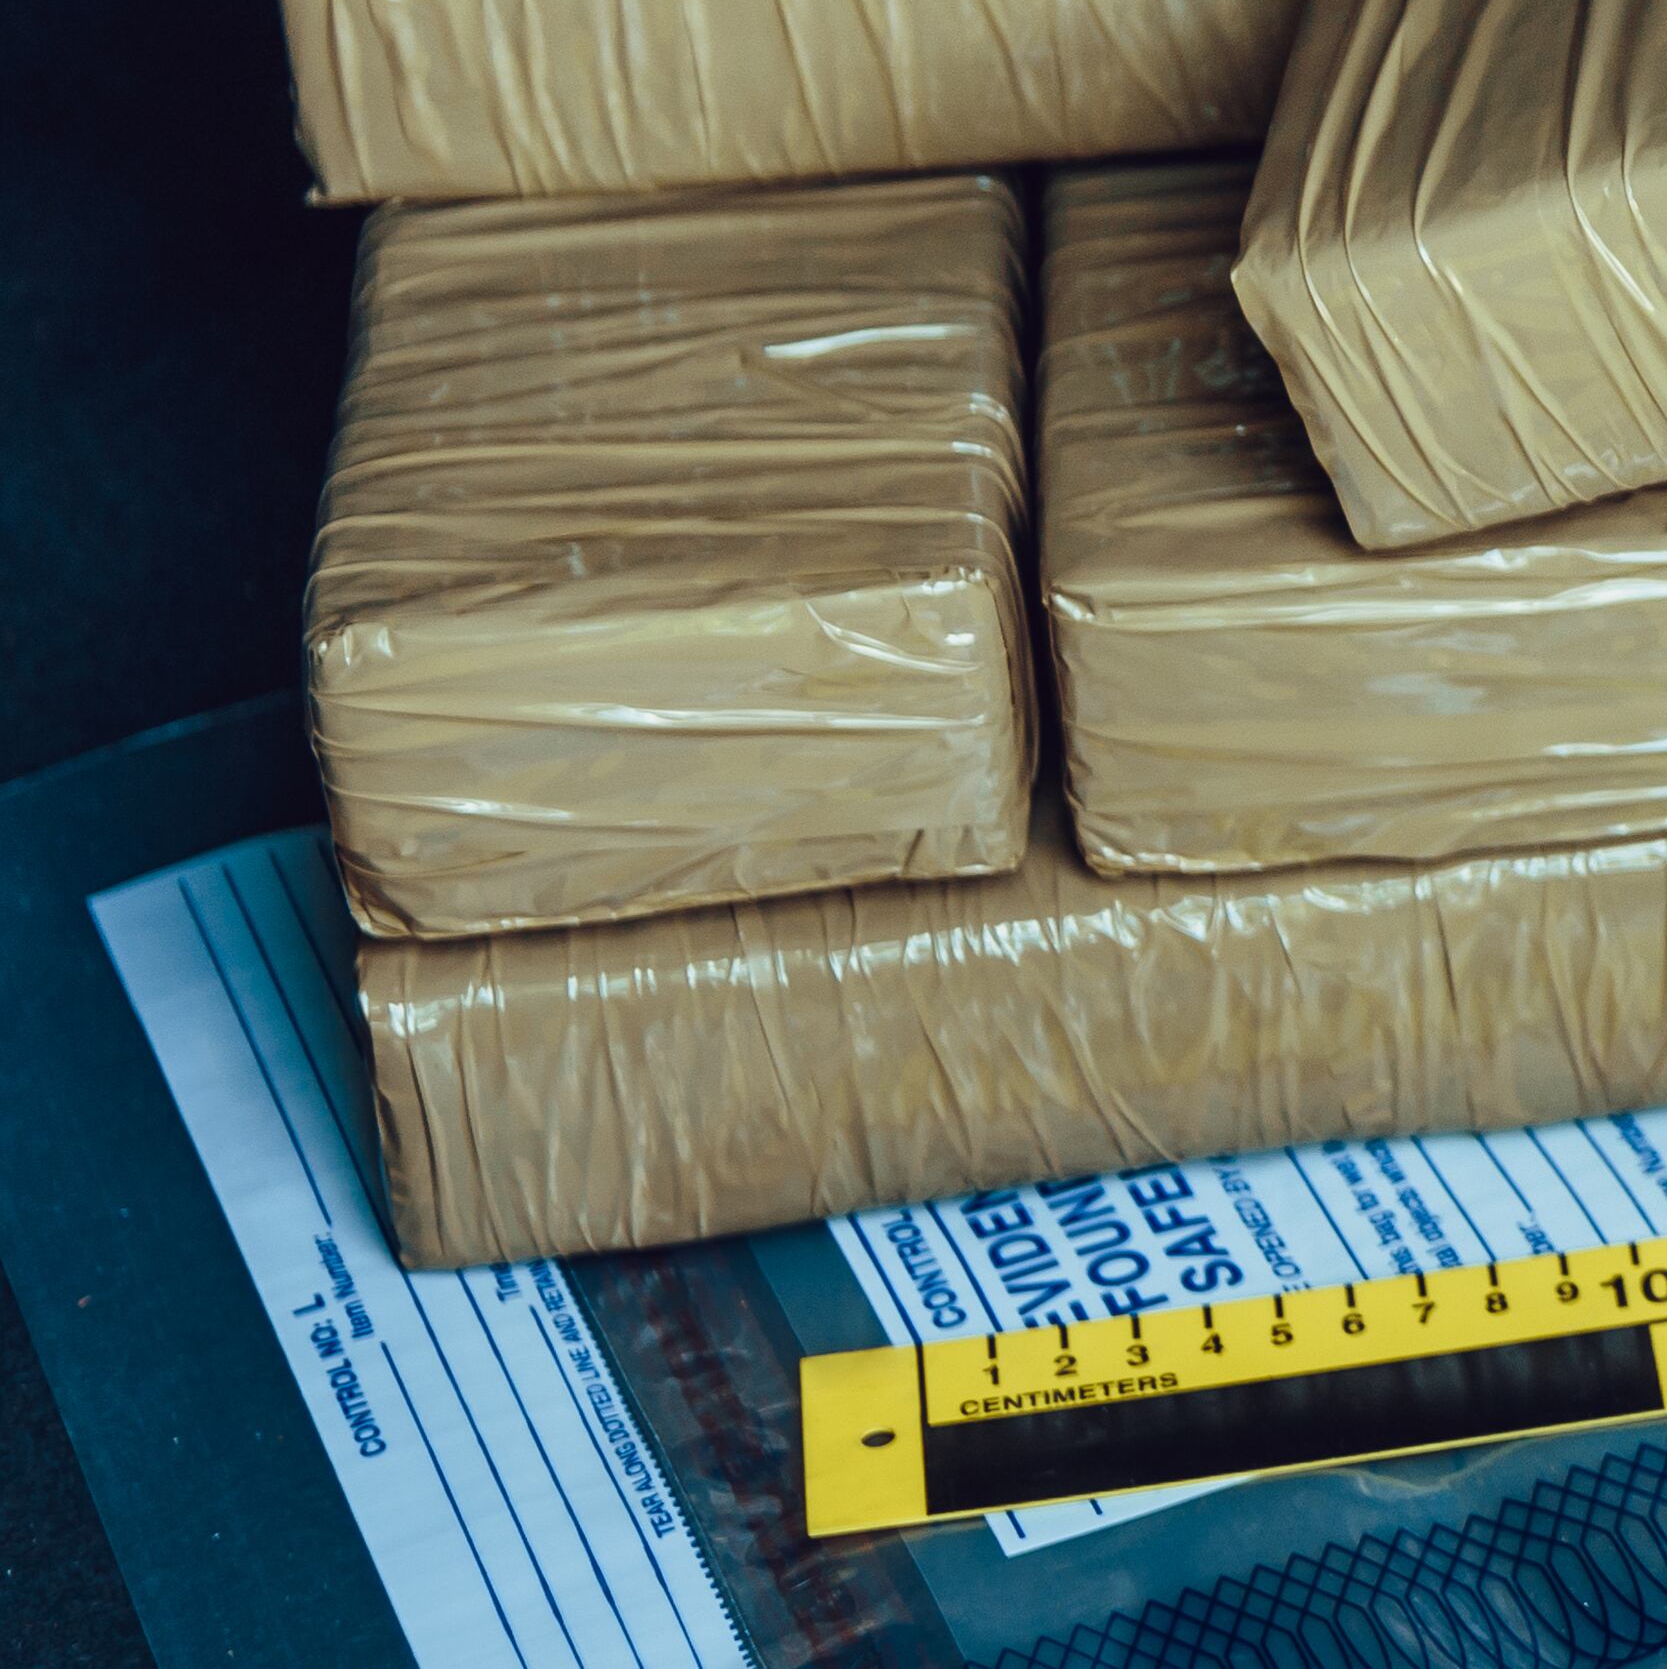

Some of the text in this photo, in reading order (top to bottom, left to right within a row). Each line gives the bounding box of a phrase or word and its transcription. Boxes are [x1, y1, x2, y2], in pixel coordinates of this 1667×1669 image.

[880, 1207, 968, 1331] CONTROL
[1232, 1196, 1302, 1280] OPENED
[313, 1230, 374, 1341] Item Number:
[551, 1312, 583, 1344] AND
[983, 1364, 1000, 1386] 1
[1054, 1354, 1077, 1377] 2
[1126, 1344, 1150, 1367] 3
[1201, 1333, 1224, 1355] 4
[1271, 1323, 1294, 1346] 5
[1341, 1313, 1366, 1335] 6
[1412, 1301, 1436, 1325] 7
[1485, 1292, 1509, 1314] 8
[1555, 1281, 1580, 1303] 9
[290, 1292, 387, 1459] CONTROL NO: L
[567, 1345, 601, 1382] LINE
[959, 1370, 1180, 1418] CENTIMETERS
[585, 1382, 630, 1444] DOTTED
[613, 1440, 655, 1494] ALONG
[640, 1492, 677, 1539] TEAR
